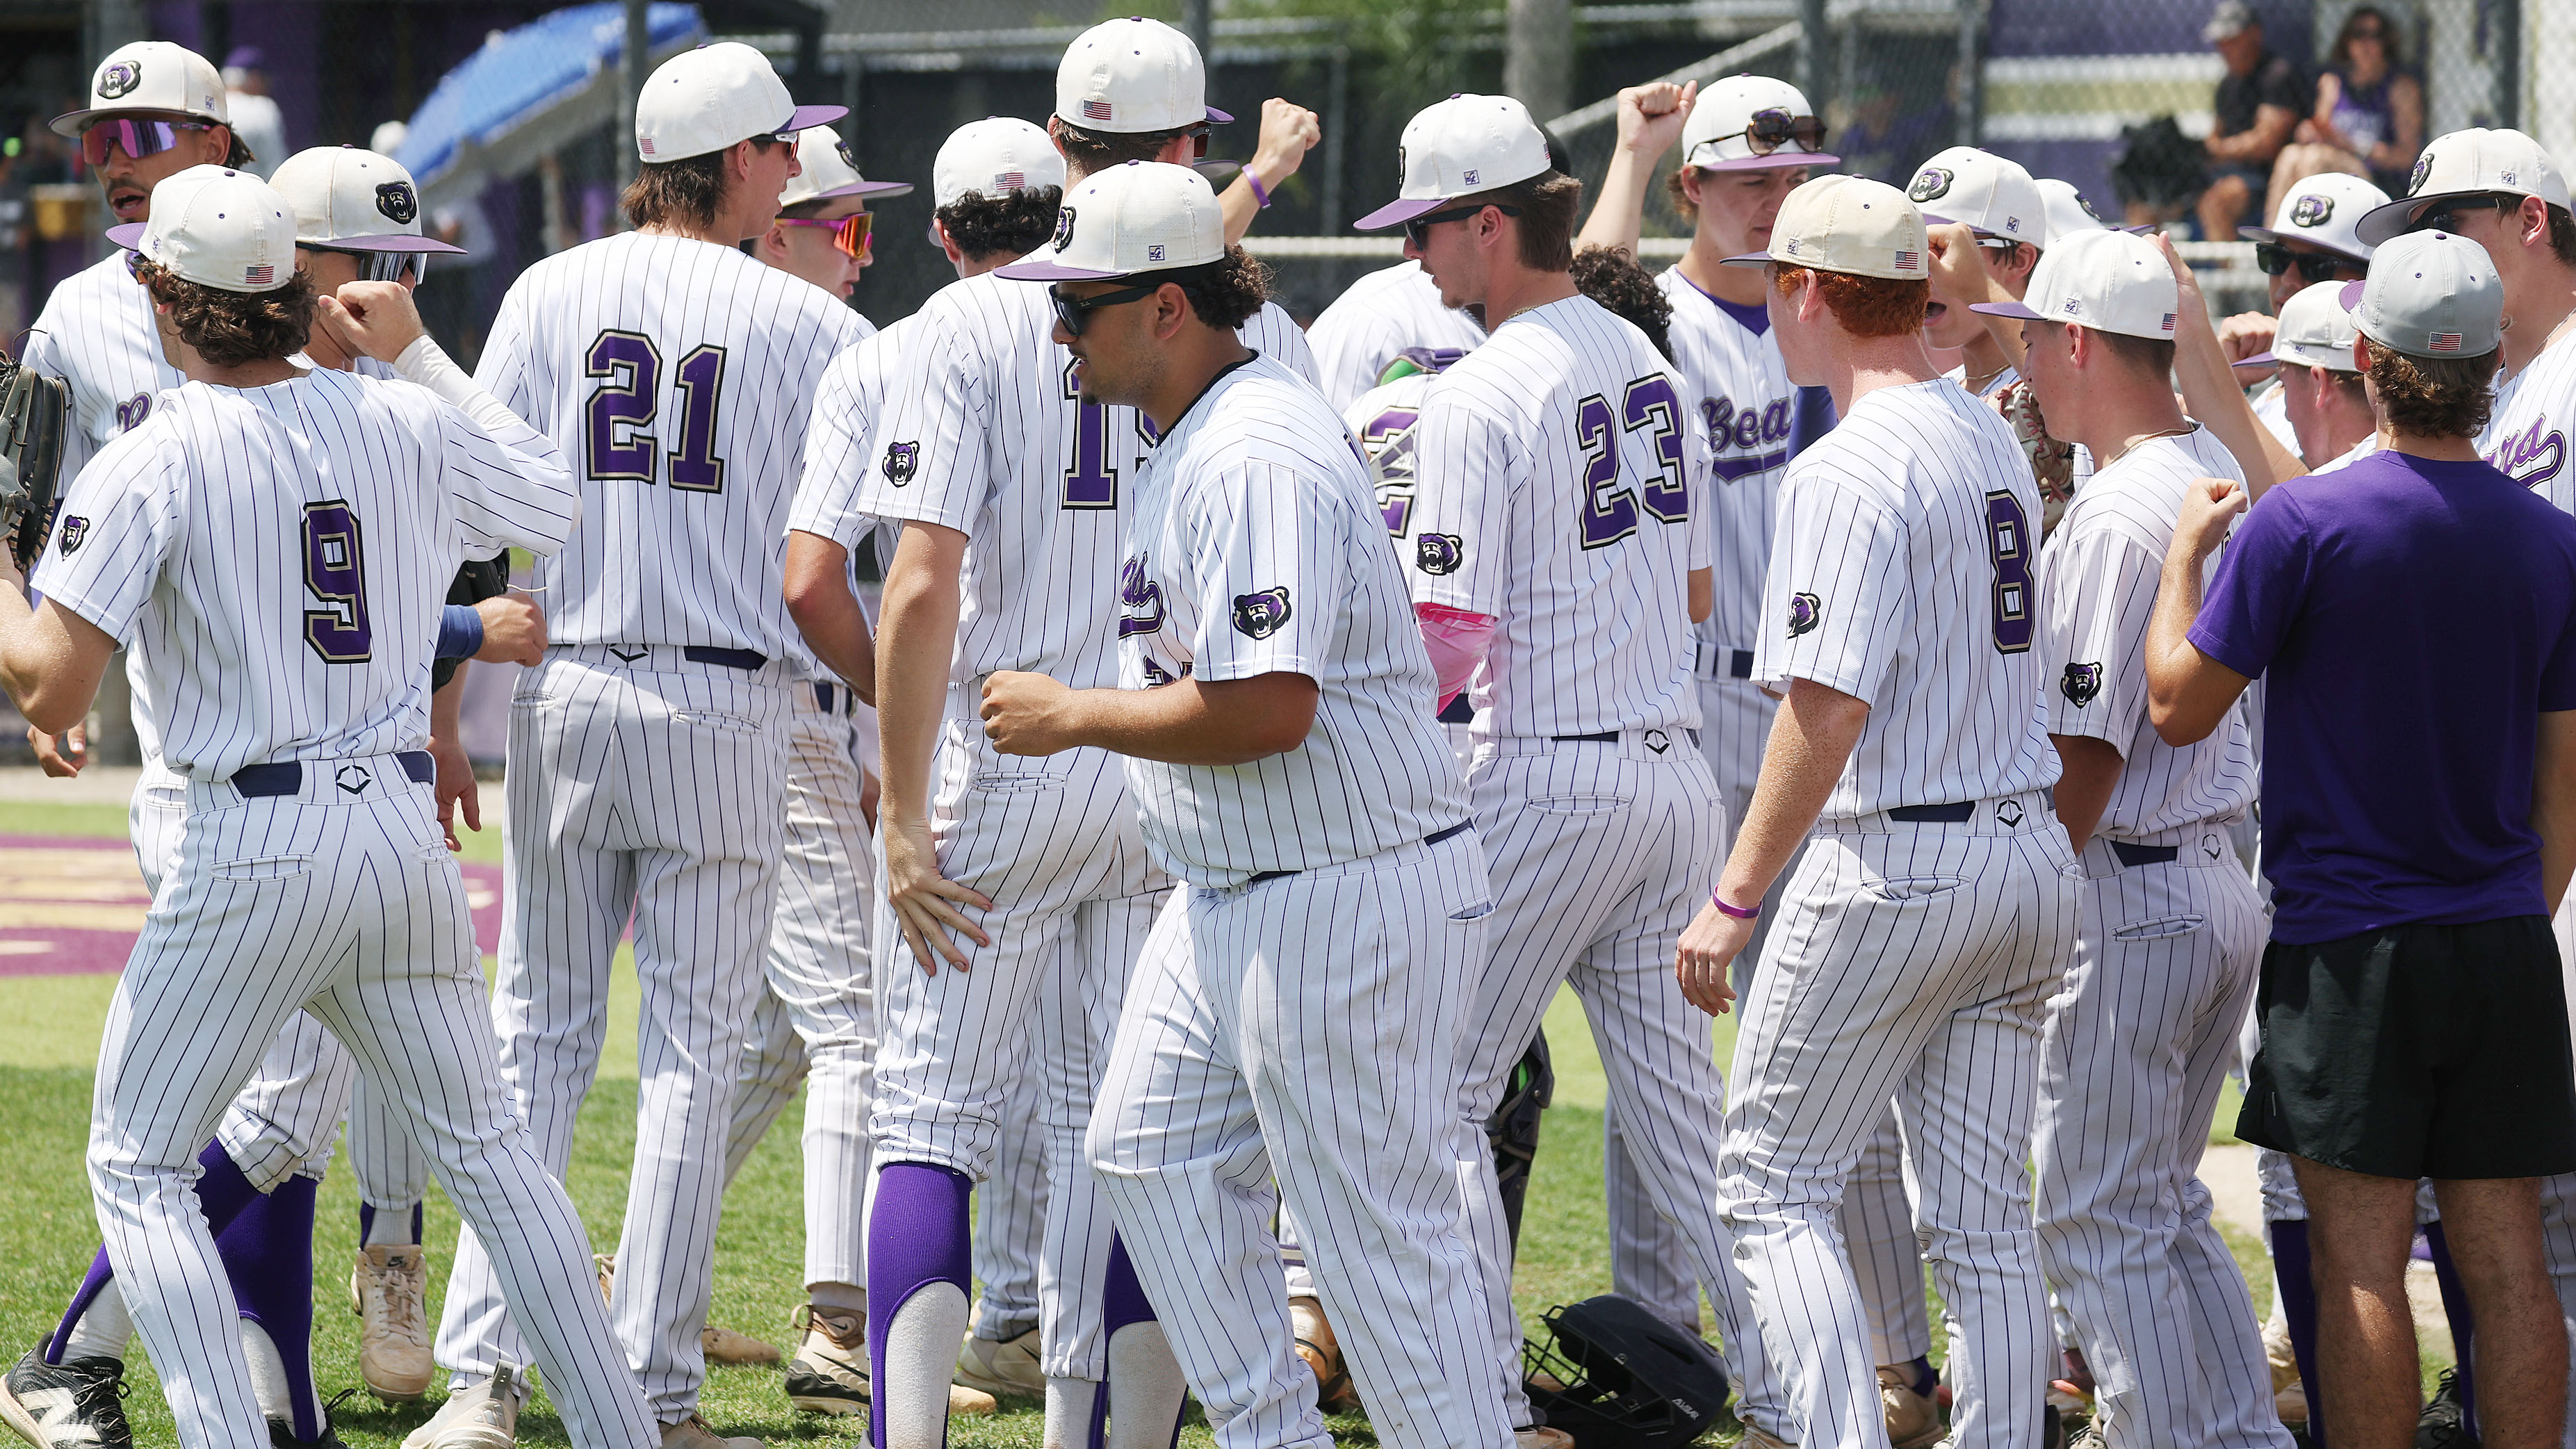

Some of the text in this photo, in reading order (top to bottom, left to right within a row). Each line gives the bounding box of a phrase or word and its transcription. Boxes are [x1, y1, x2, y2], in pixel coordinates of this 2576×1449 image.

[585, 329, 728, 493] 21
[1061, 356, 1155, 510] 1
[1576, 371, 1689, 550] 23
[1700, 395, 1796, 453] Bea
[301, 499, 373, 664] 9
[1986, 489, 2035, 655] 8
